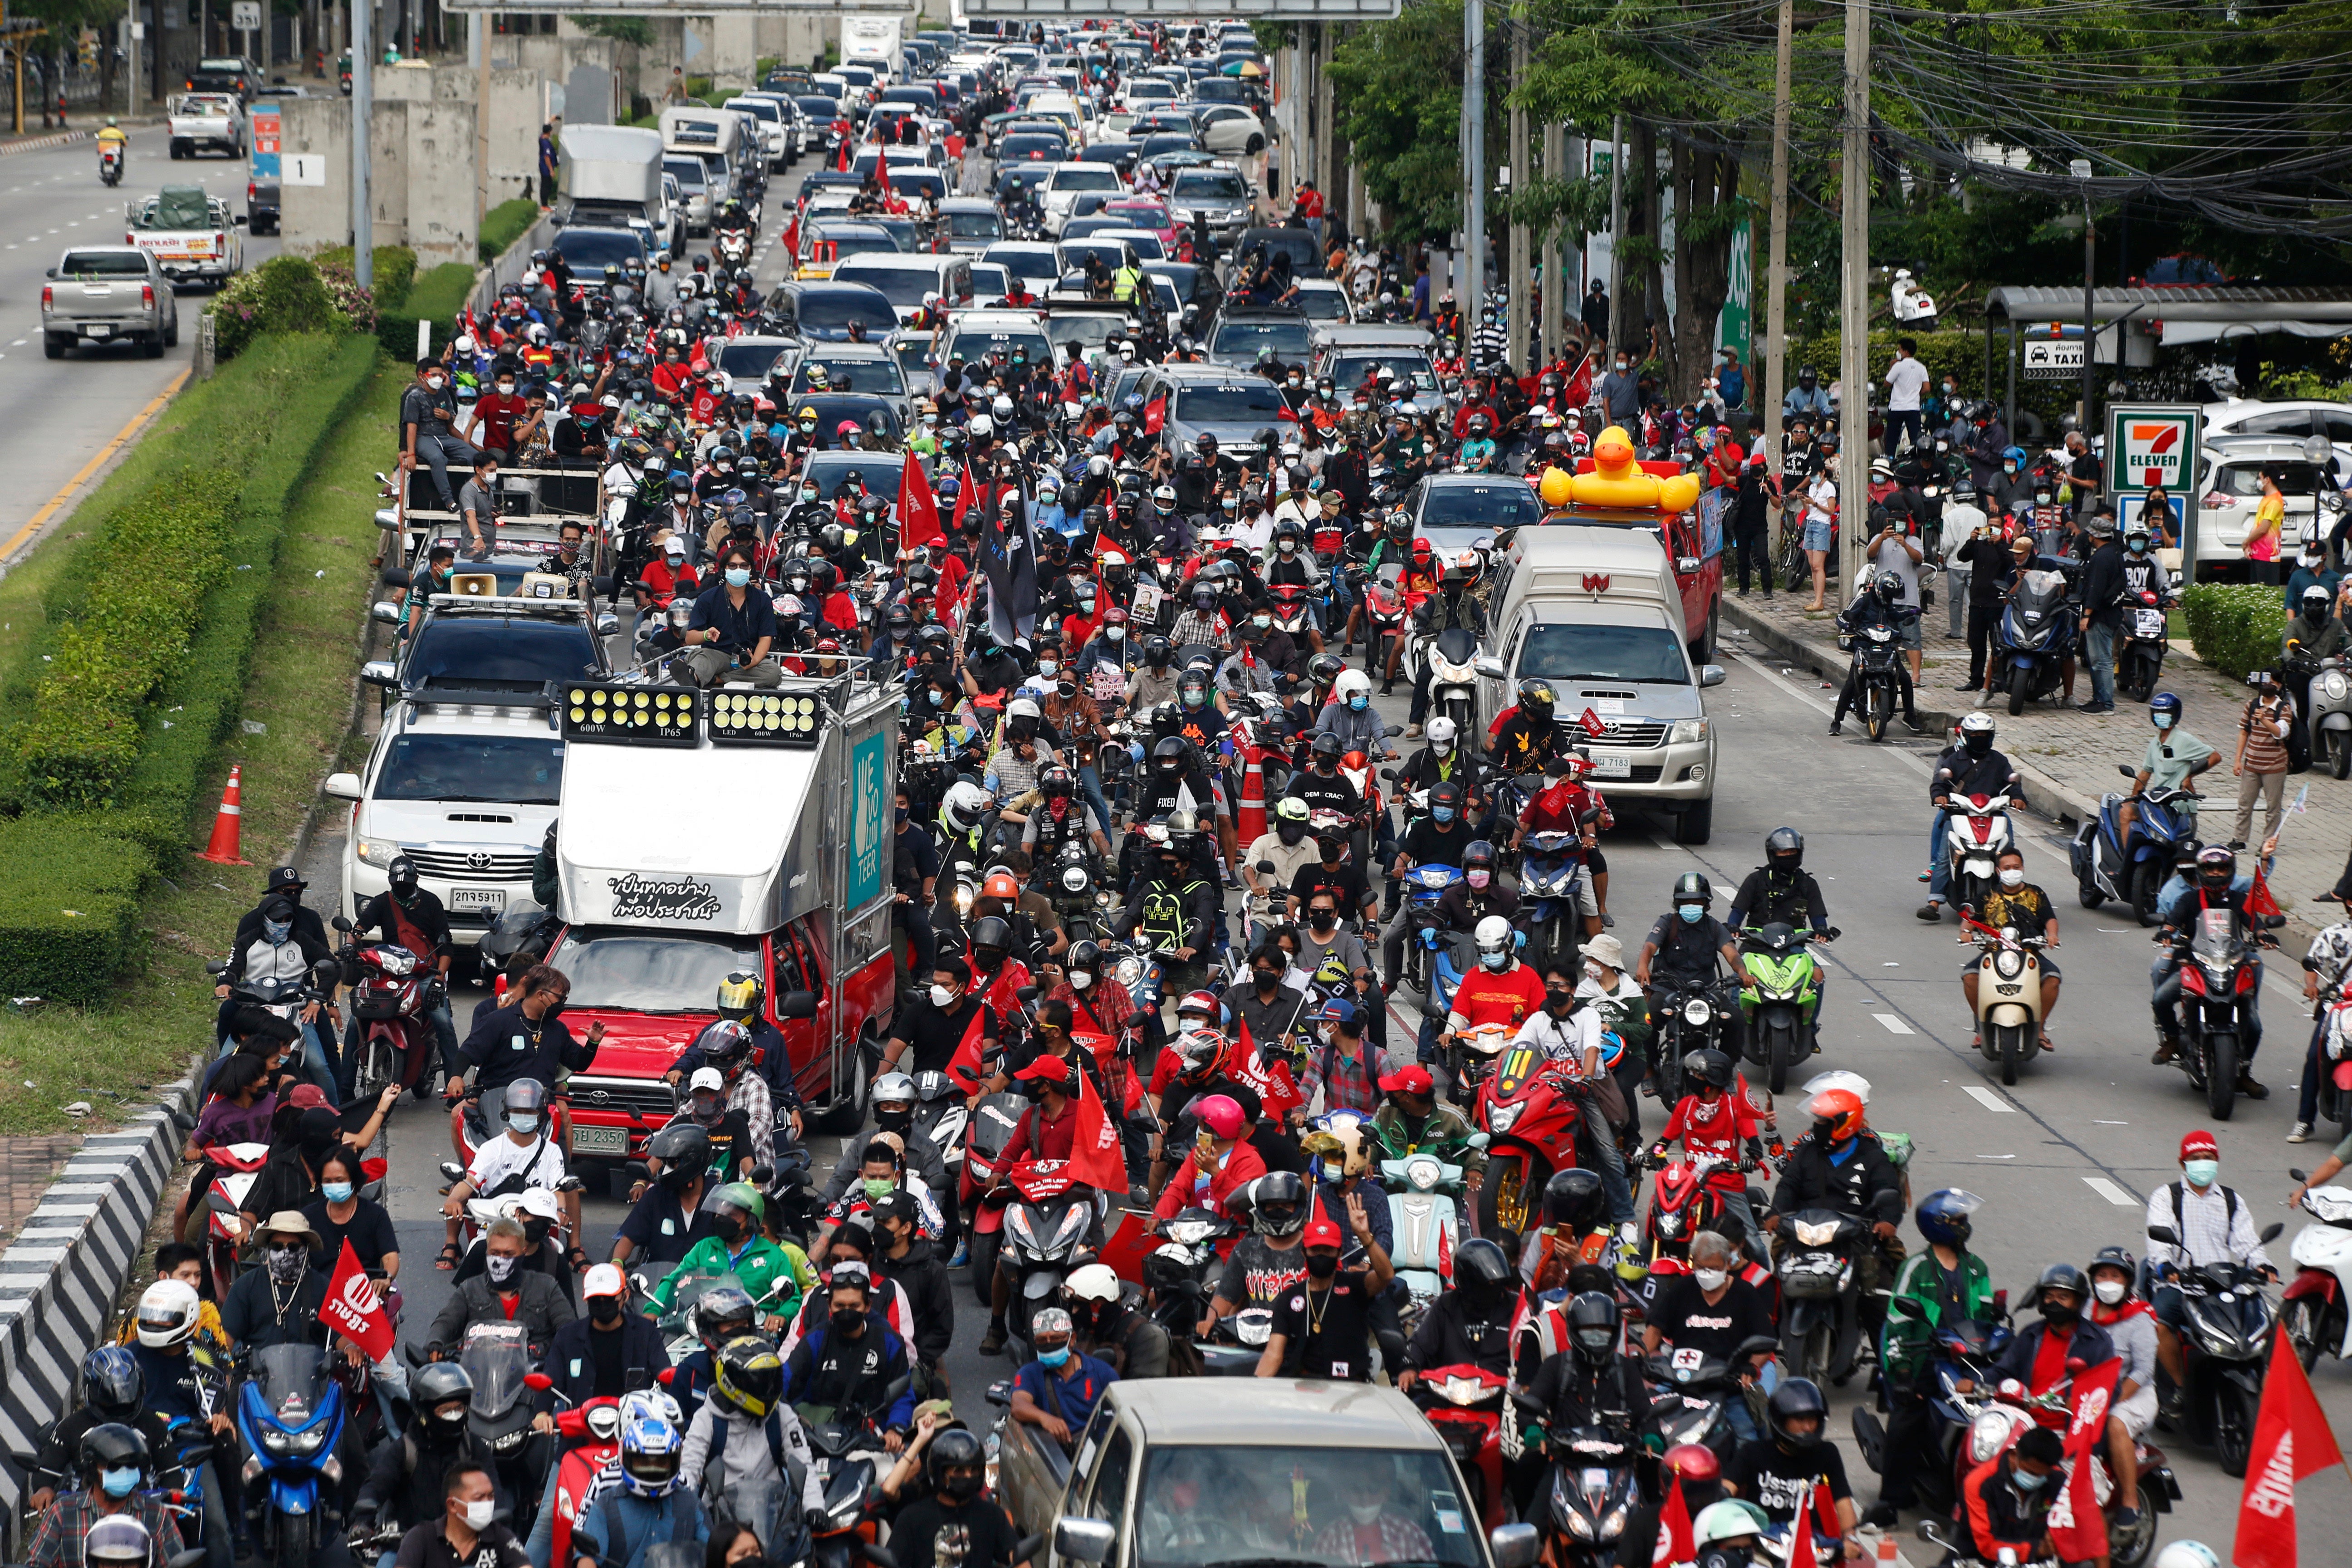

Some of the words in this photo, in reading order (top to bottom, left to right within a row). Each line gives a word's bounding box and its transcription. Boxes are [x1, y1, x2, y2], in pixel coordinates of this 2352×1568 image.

[2056, 343, 2082, 351] ต้องการ
[2054, 354, 2083, 364] TAXI
[2125, 567, 2150, 587] BOY
[2025, 610, 2041, 618] PRESS
[580, 723, 606, 734] 600W
[660, 726, 681, 737] IP65
[1609, 758, 1628, 767] 7183
[1157, 797, 1176, 808] FIXED
[456, 892, 476, 902] 2กจ
[479, 892, 501, 902] 5911
[594, 1130, 624, 1143] 2350
[1586, 1247, 1601, 1259] 27
[328, 1298, 371, 1334] ราษฎร
